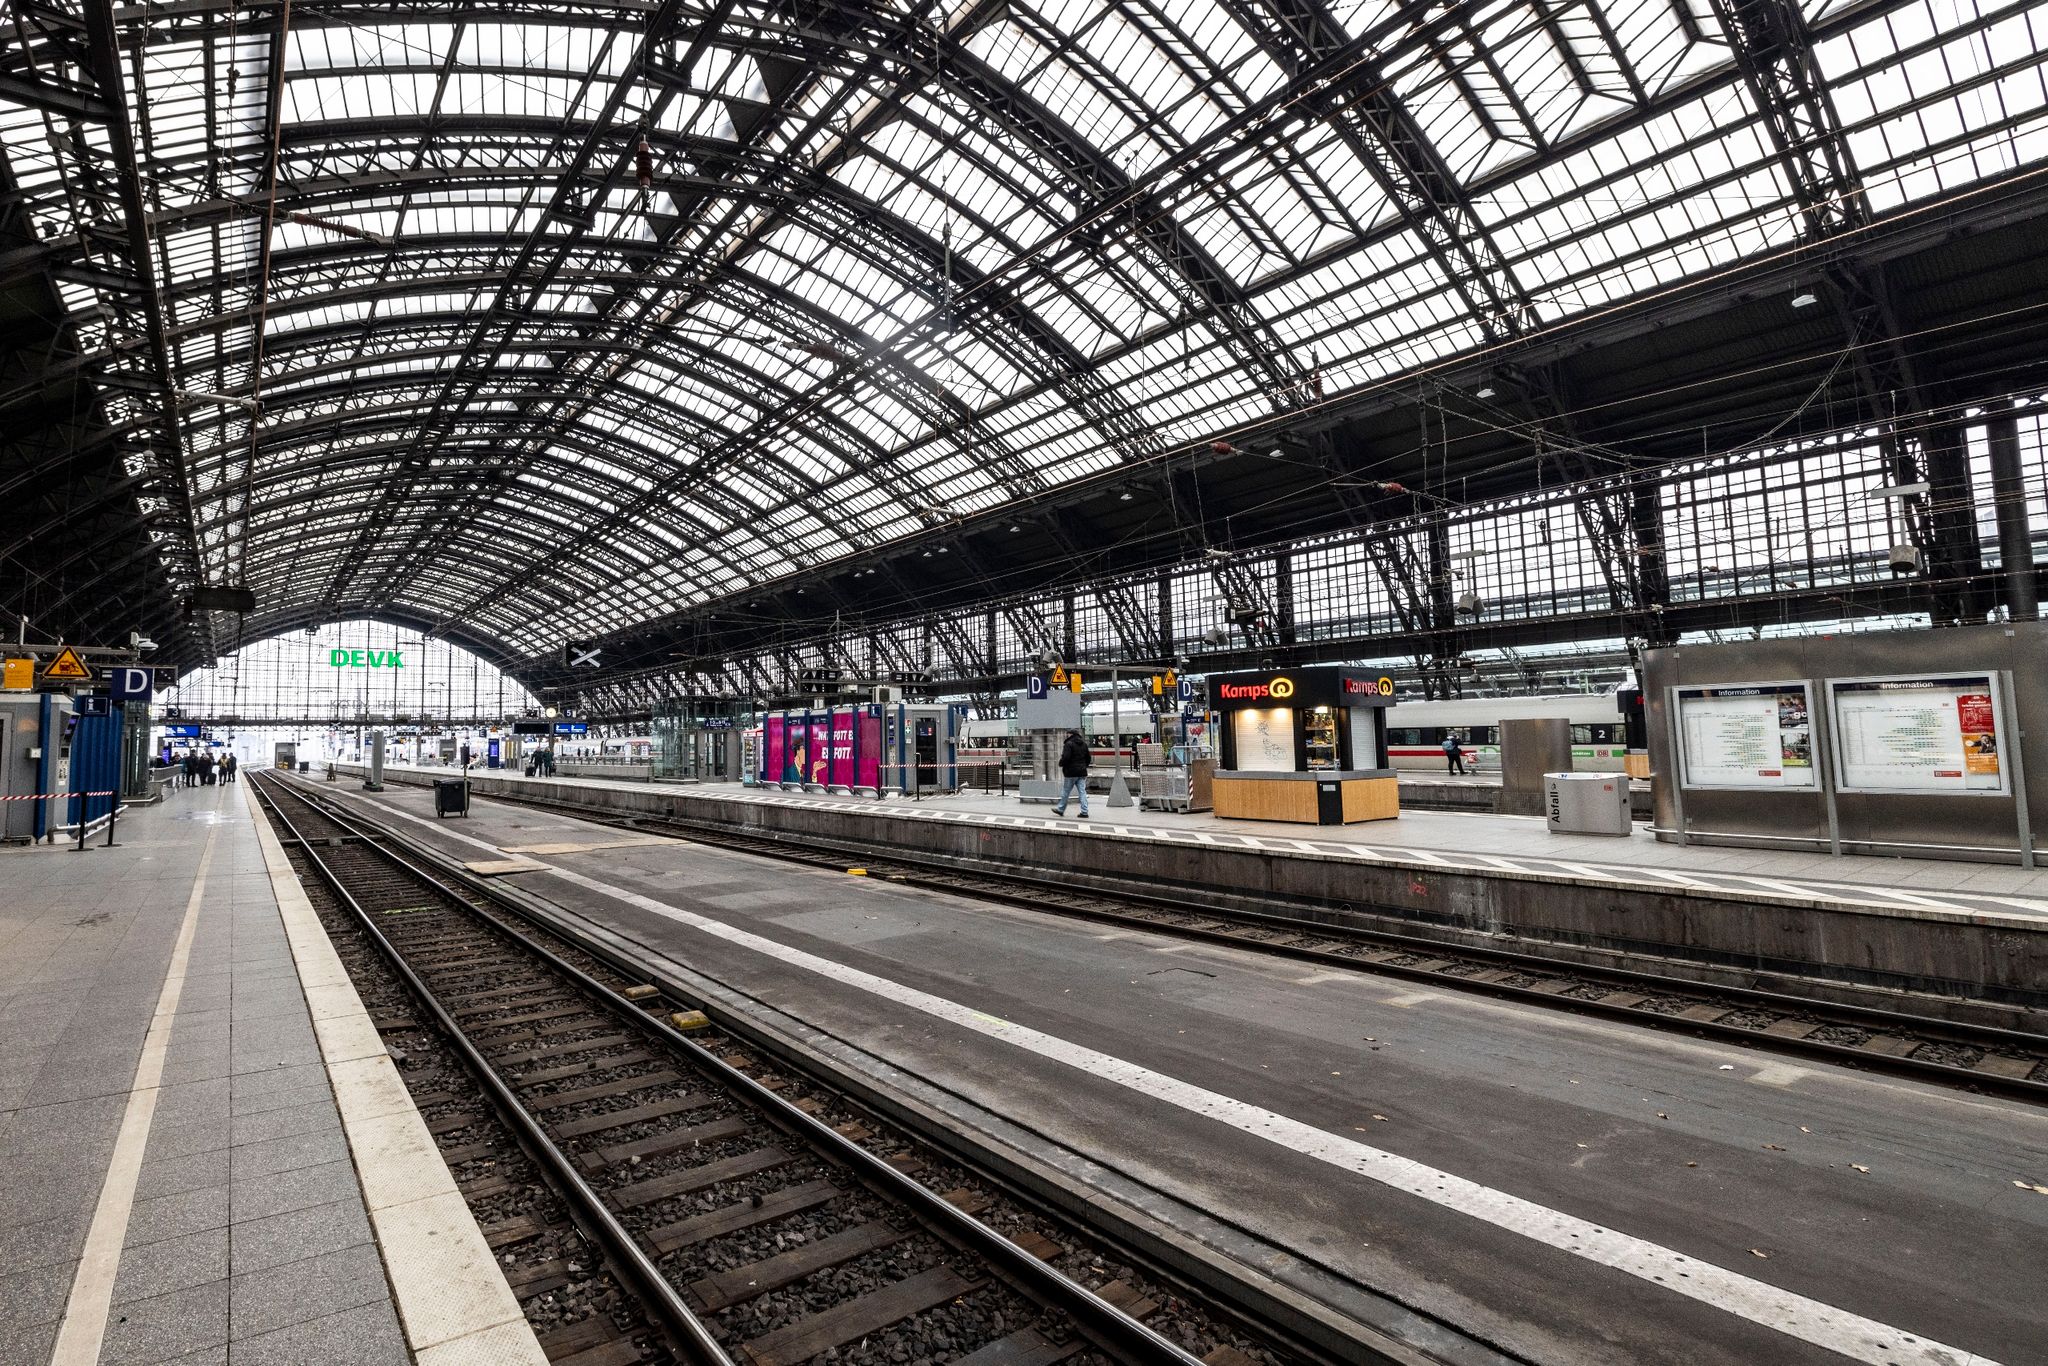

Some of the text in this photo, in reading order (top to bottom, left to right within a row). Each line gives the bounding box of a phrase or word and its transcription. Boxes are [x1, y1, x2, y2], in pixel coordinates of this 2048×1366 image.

[330, 649, 404, 668] DEVK
[125, 668, 148, 693] D
[1031, 676, 1042, 694] D
[1344, 678, 1378, 696] Kamps
[1882, 681, 1934, 690] Information
[1182, 681, 1191, 697] D
[1220, 683, 1269, 700] Kamps
[1718, 688, 1760, 697] Information
[172, 708, 179, 716] 3
[566, 709, 572, 717] 5
[1187, 705, 1193, 715] D
[833, 729, 847, 741] FOTT
[1598, 730, 1606, 739] 2
[1550, 791, 1560, 824] Abfall
